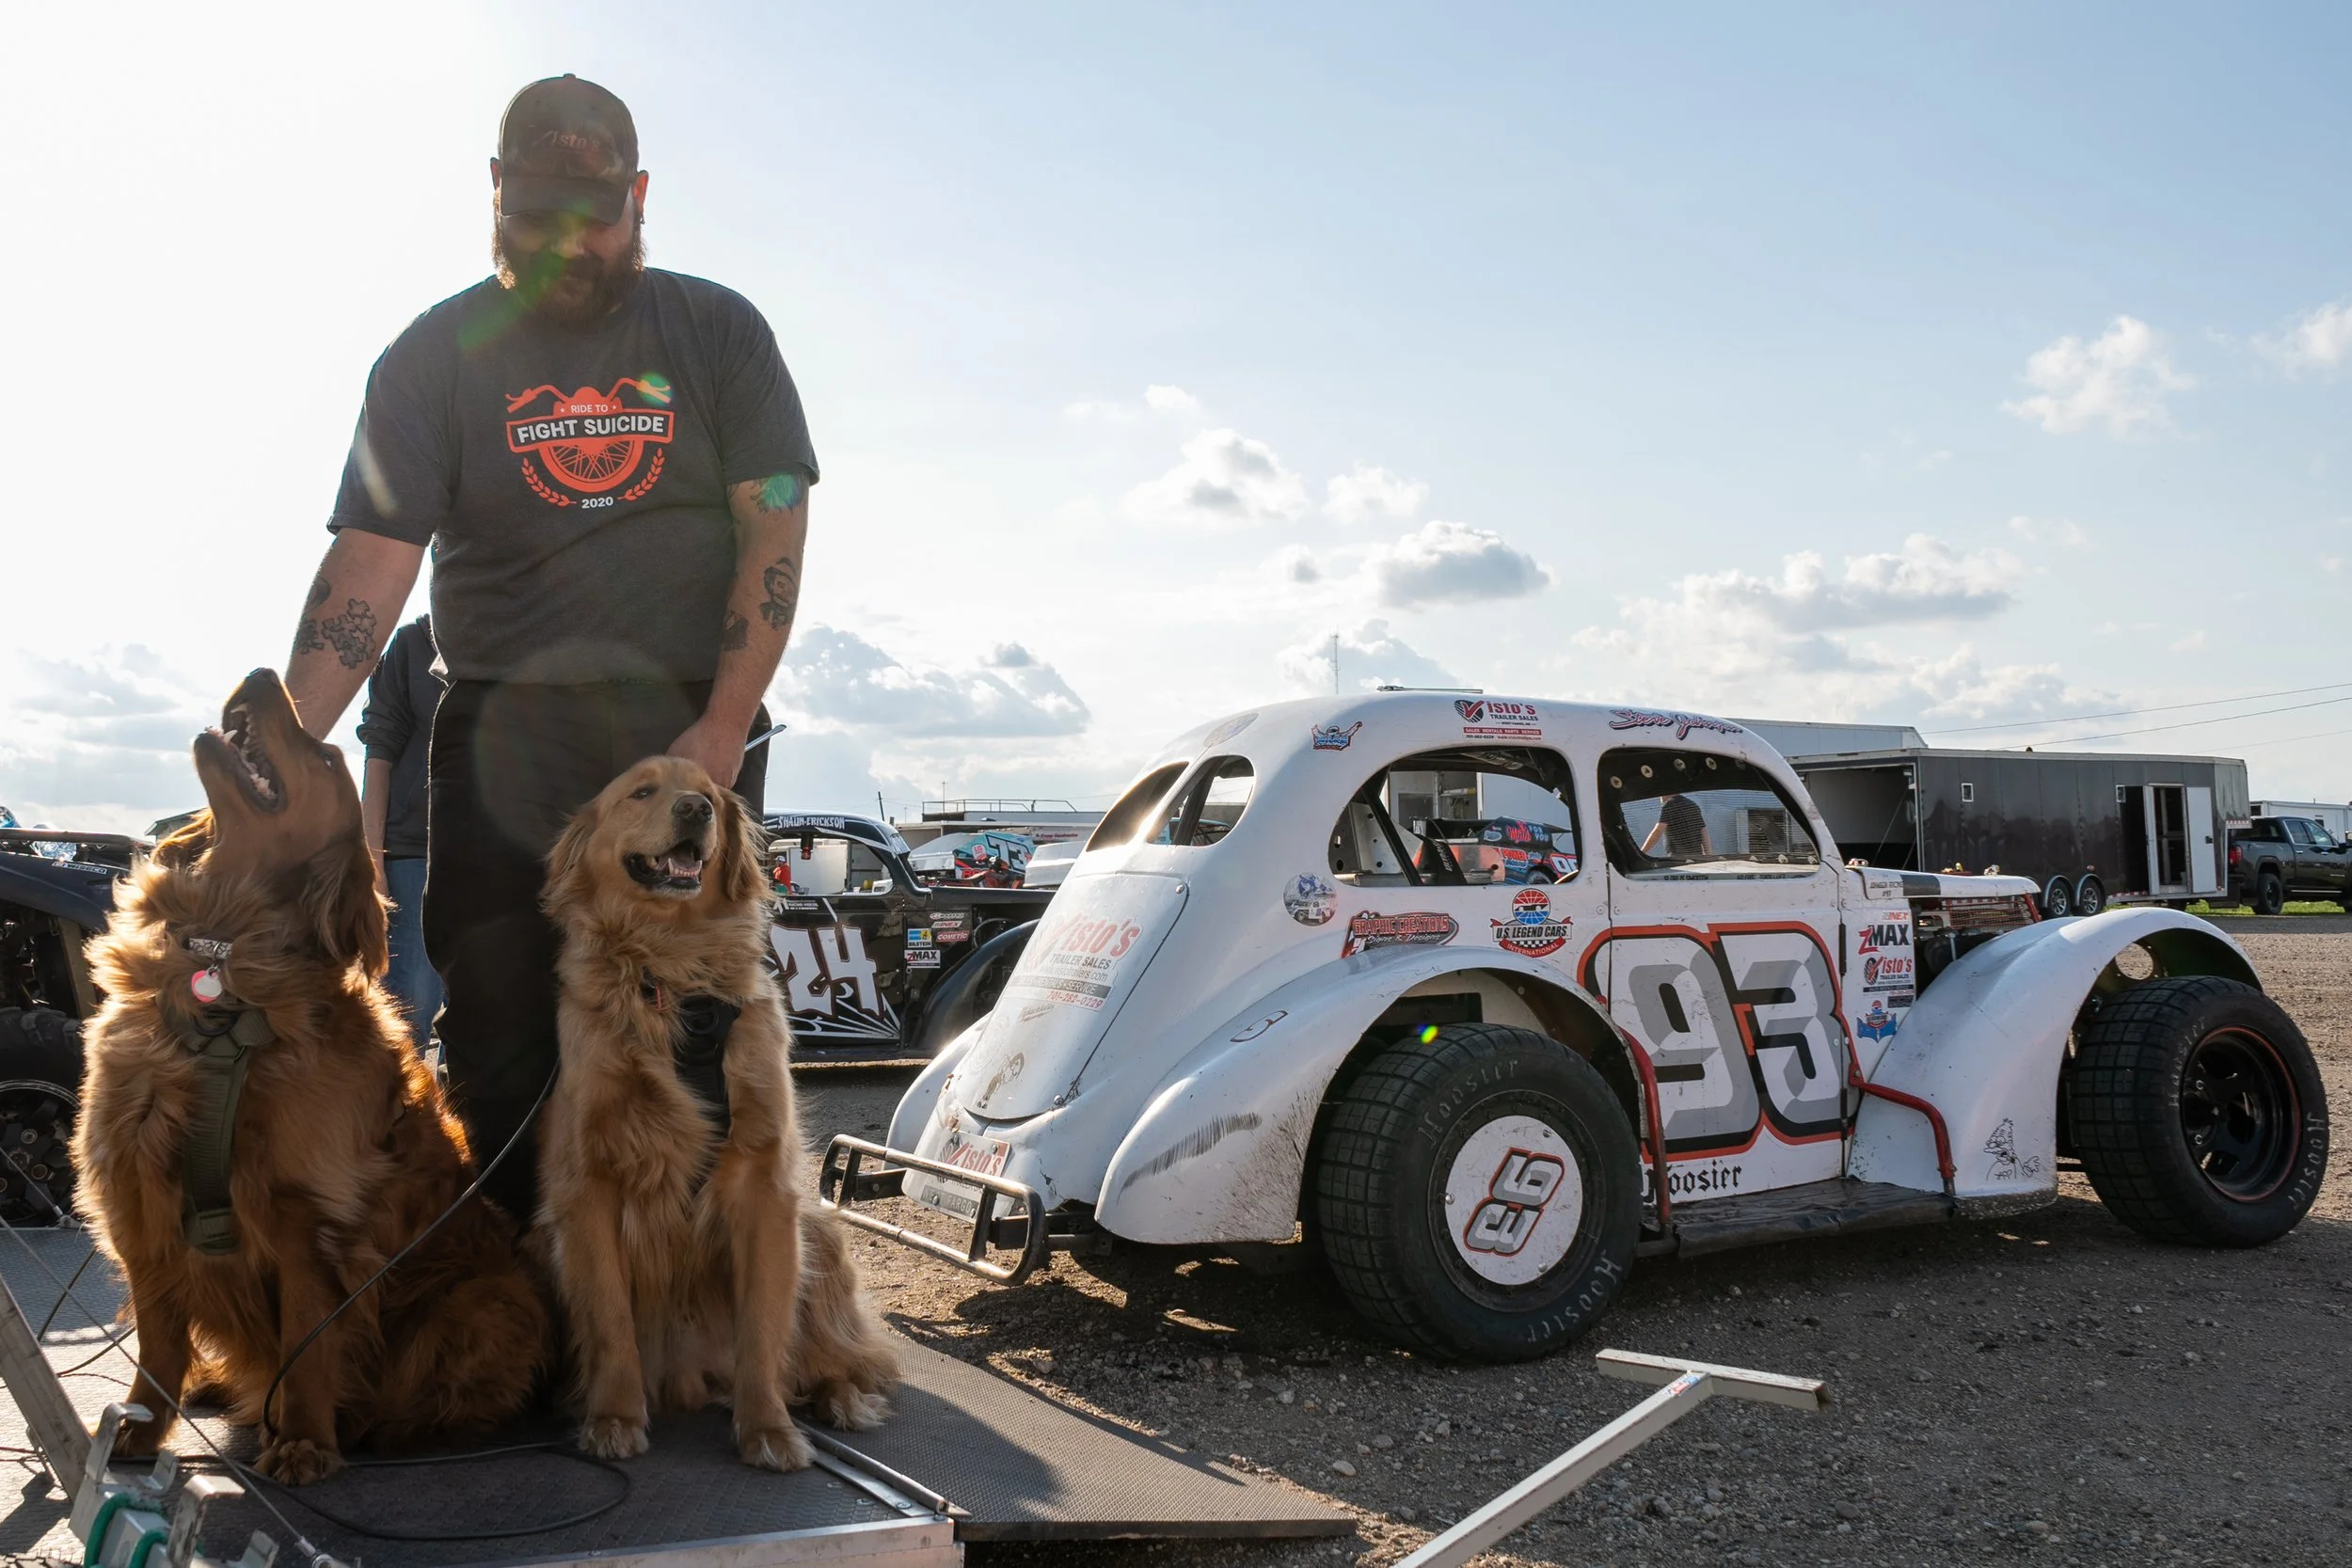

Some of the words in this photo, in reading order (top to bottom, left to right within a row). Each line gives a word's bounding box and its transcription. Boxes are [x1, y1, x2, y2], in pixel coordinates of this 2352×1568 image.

[570, 404, 593, 414] RIDE
[596, 404, 609, 413] TO
[516, 420, 578, 444] FIGHT
[583, 415, 665, 436] SUICIDE
[580, 497, 614, 509] 2020
[1534, 833, 1549, 843] YOU
[1353, 919, 1396, 935] GRAPHIC
[1398, 916, 1450, 934] CREATIONS
[1512, 926, 1544, 939] LEGEND
[936, 931, 968, 941] COMETIC
[1366, 934, 1392, 944] Signs
[1395, 934, 1403, 942] &
[1406, 933, 1441, 942] Designs
[1506, 942, 1560, 956] INTERNATIONAL
[1050, 953, 1084, 966] TRAILER
[1082, 956, 1112, 970] SALES
[769, 923, 882, 1018] 24
[1066, 980, 1099, 995] SERVICE
[1581, 926, 1855, 1155] 93
[947, 1194, 972, 1213] FARGO
